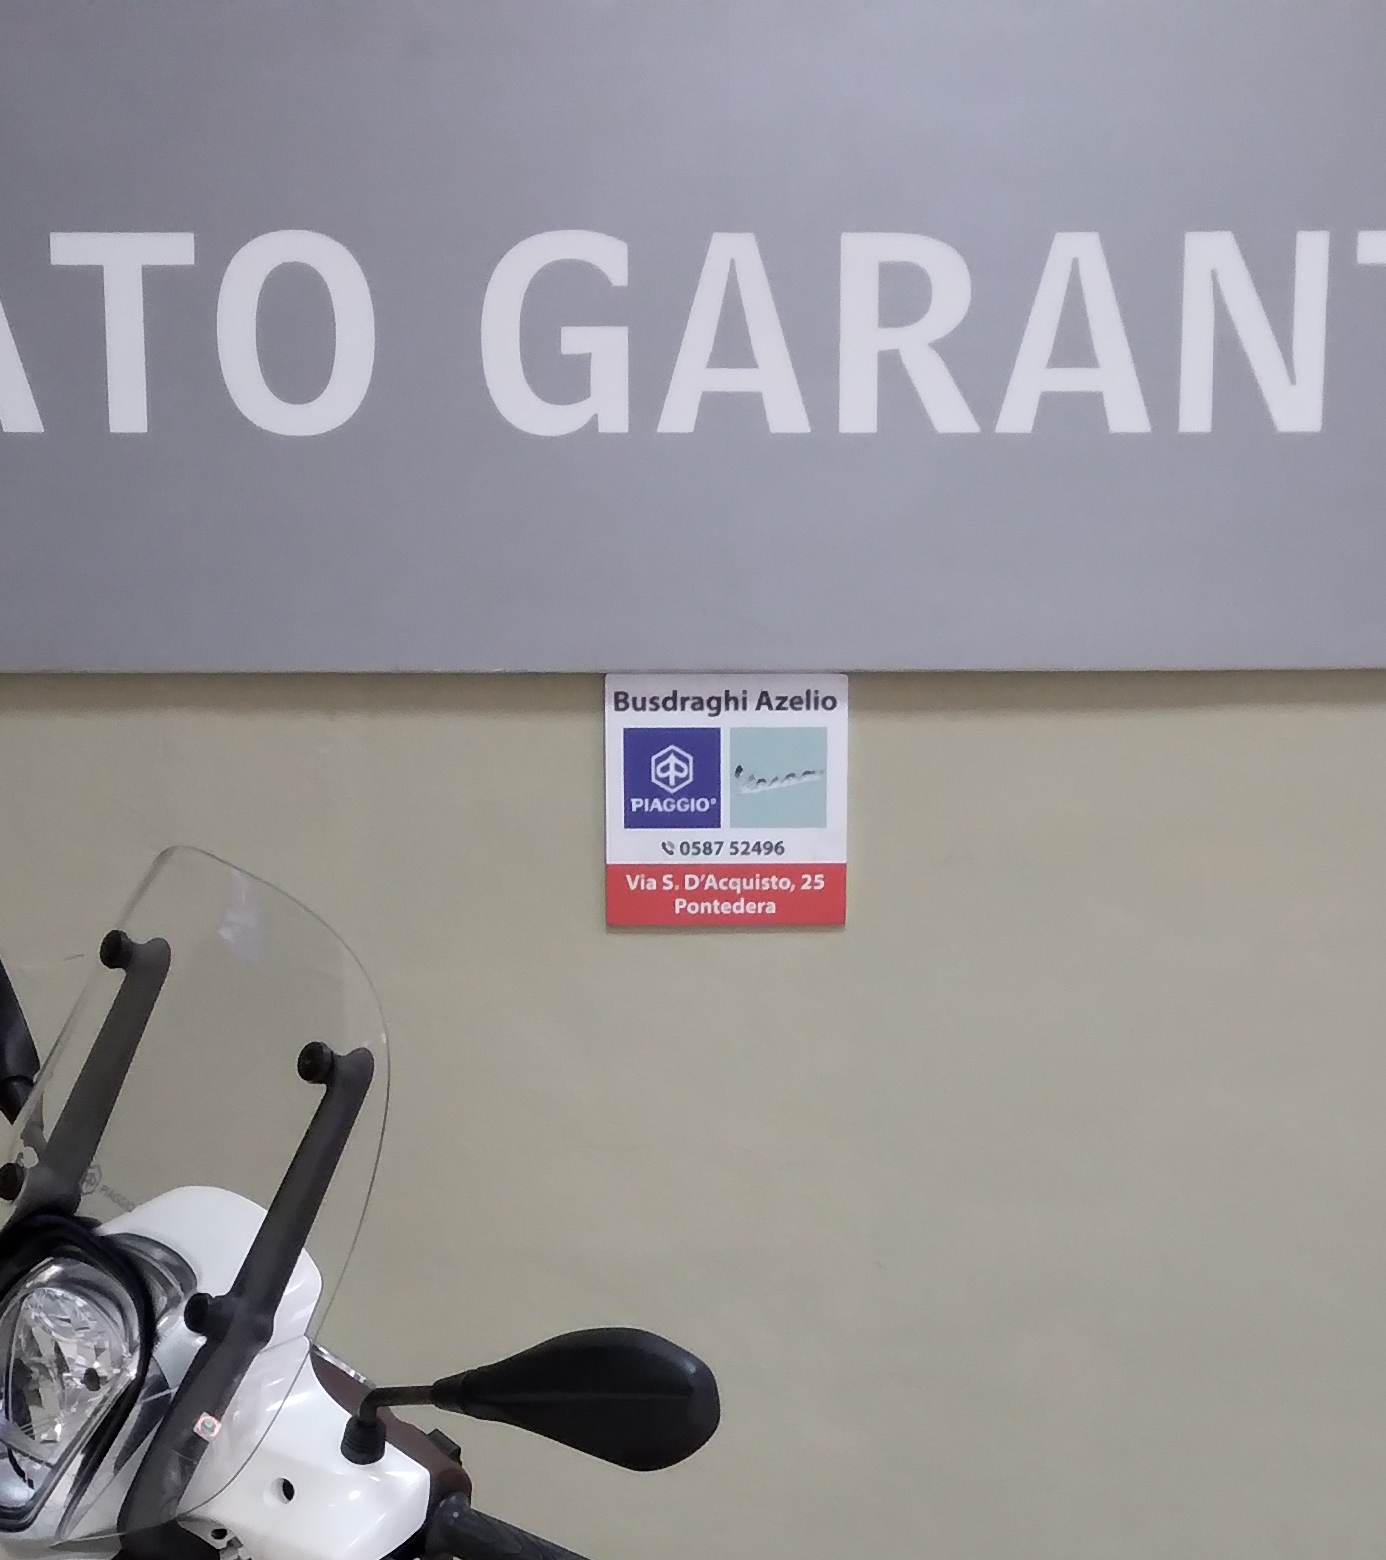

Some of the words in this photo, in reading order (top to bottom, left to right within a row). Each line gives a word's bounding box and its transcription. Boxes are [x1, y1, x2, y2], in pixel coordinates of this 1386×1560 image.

[613, 689, 748, 717] Busdraghi
[754, 689, 838, 712] Azelio
[679, 840, 724, 856] 0587
[729, 840, 786, 856] 52496
[625, 874, 657, 891] Via
[662, 874, 680, 891] S.
[684, 874, 796, 894] D'Acquisto,
[800, 873, 826, 891] 25
[674, 897, 777, 915] Pontedera
